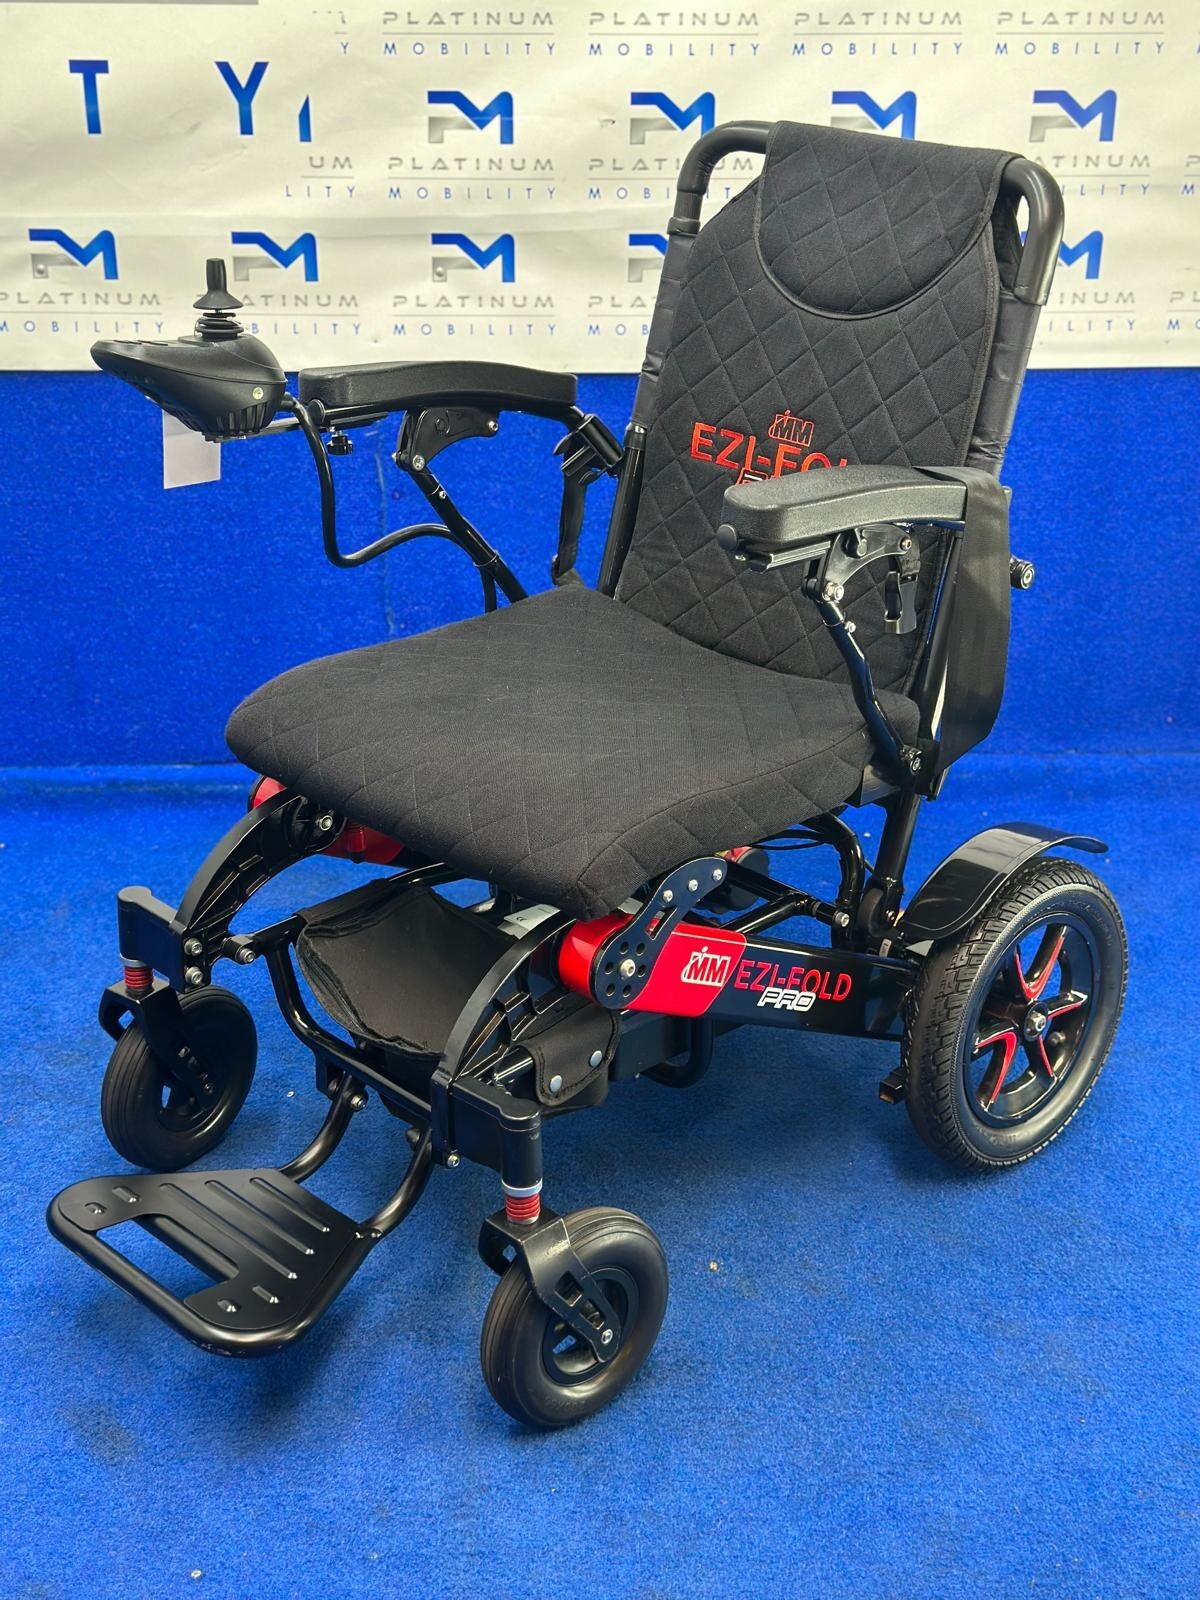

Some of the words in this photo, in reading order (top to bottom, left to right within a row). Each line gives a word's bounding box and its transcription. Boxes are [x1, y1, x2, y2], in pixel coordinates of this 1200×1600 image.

[383, 12, 553, 25] PLATINUM
[589, 12, 759, 26] PLATINUM
[794, 12, 961, 26] PLATINUM
[998, 11, 1164, 25] PLATINUM
[384, 42, 554, 55] MOBILITY
[589, 43, 760, 56] MOBILITY
[792, 42, 962, 56] MOBILITY
[995, 41, 1164, 55] MOBILITY
[388, 157, 554, 171] PLATINUM
[589, 158, 753, 171] PLATIUM
[389, 187, 555, 200] MOBILITY
[393, 295, 554, 308] PLATINUM
[393, 323, 556, 336] MOBILITY
[733, 959, 852, 1001] EZI-FOLD
[757, 987, 816, 1012] PRO
